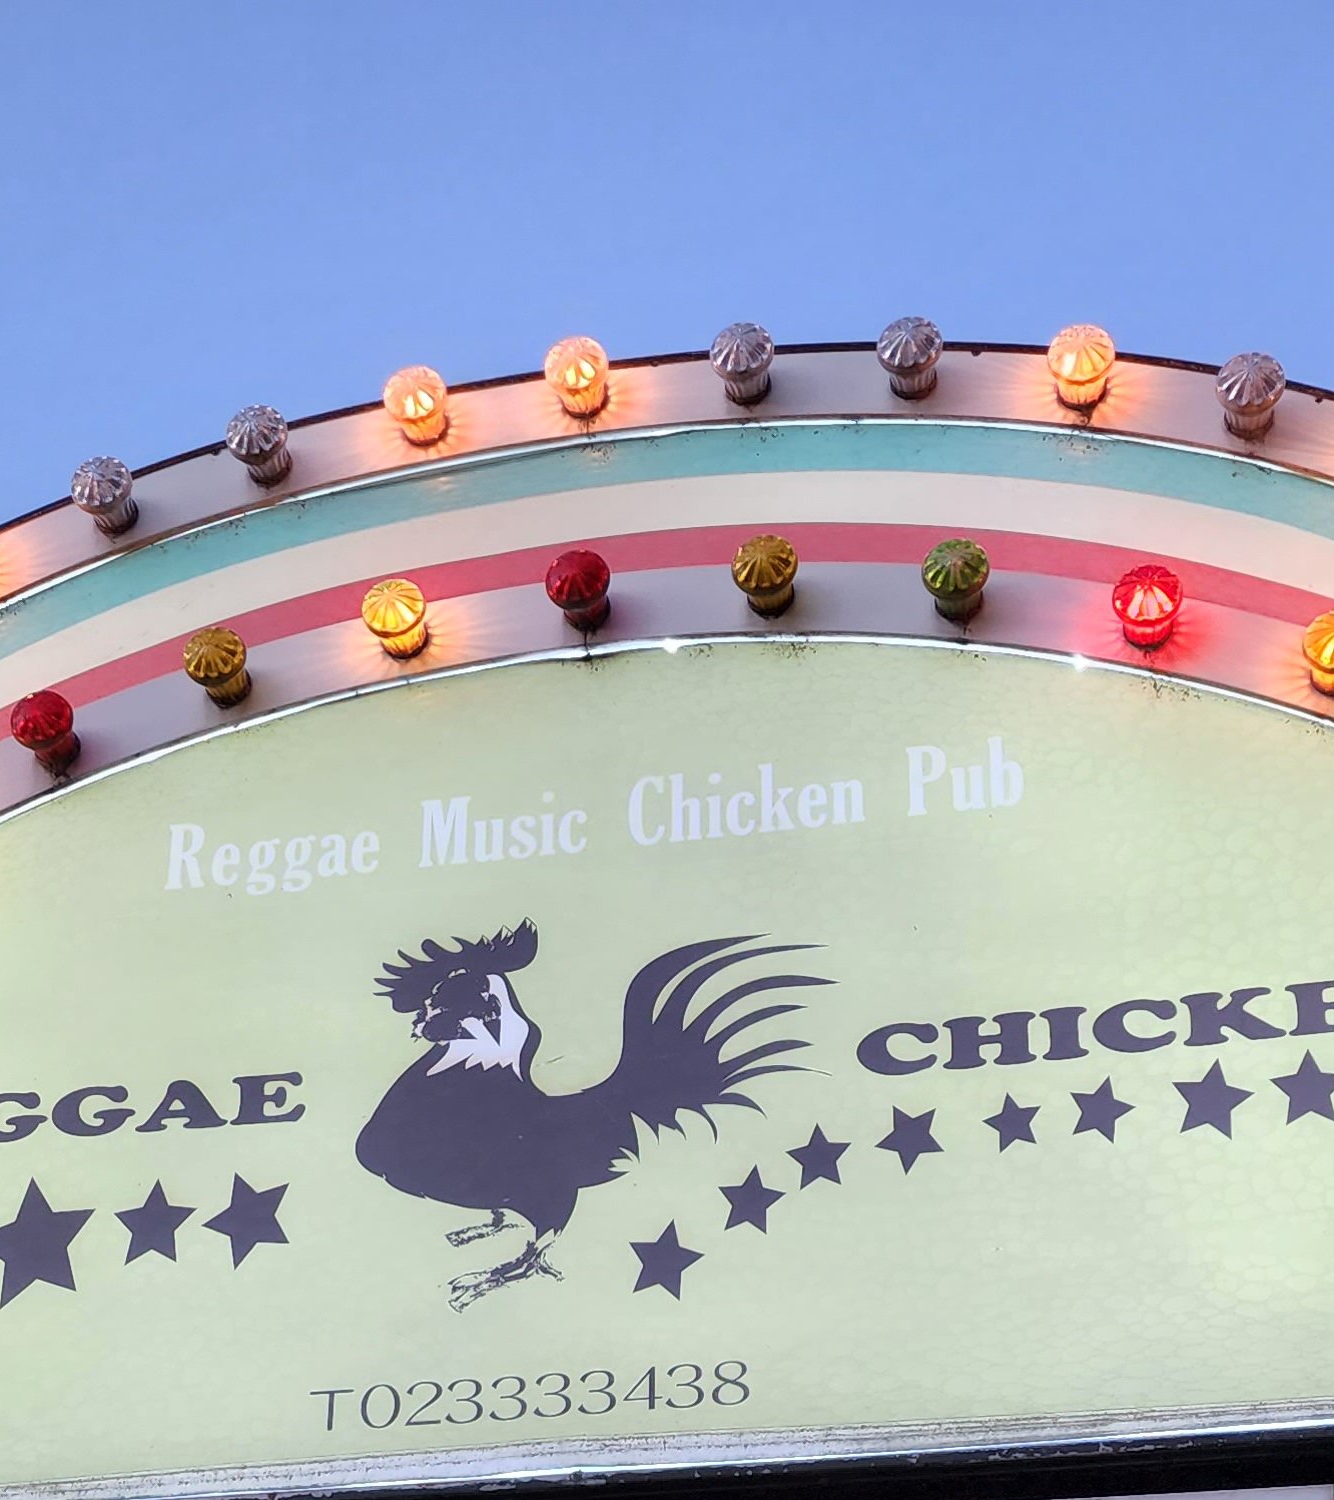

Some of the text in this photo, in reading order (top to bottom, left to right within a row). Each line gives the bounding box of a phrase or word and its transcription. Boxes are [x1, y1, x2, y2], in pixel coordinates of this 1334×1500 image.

[164, 735, 1025, 896] Reggae Music Chicken Pub
[309, 1360, 750, 1432] T023333438
